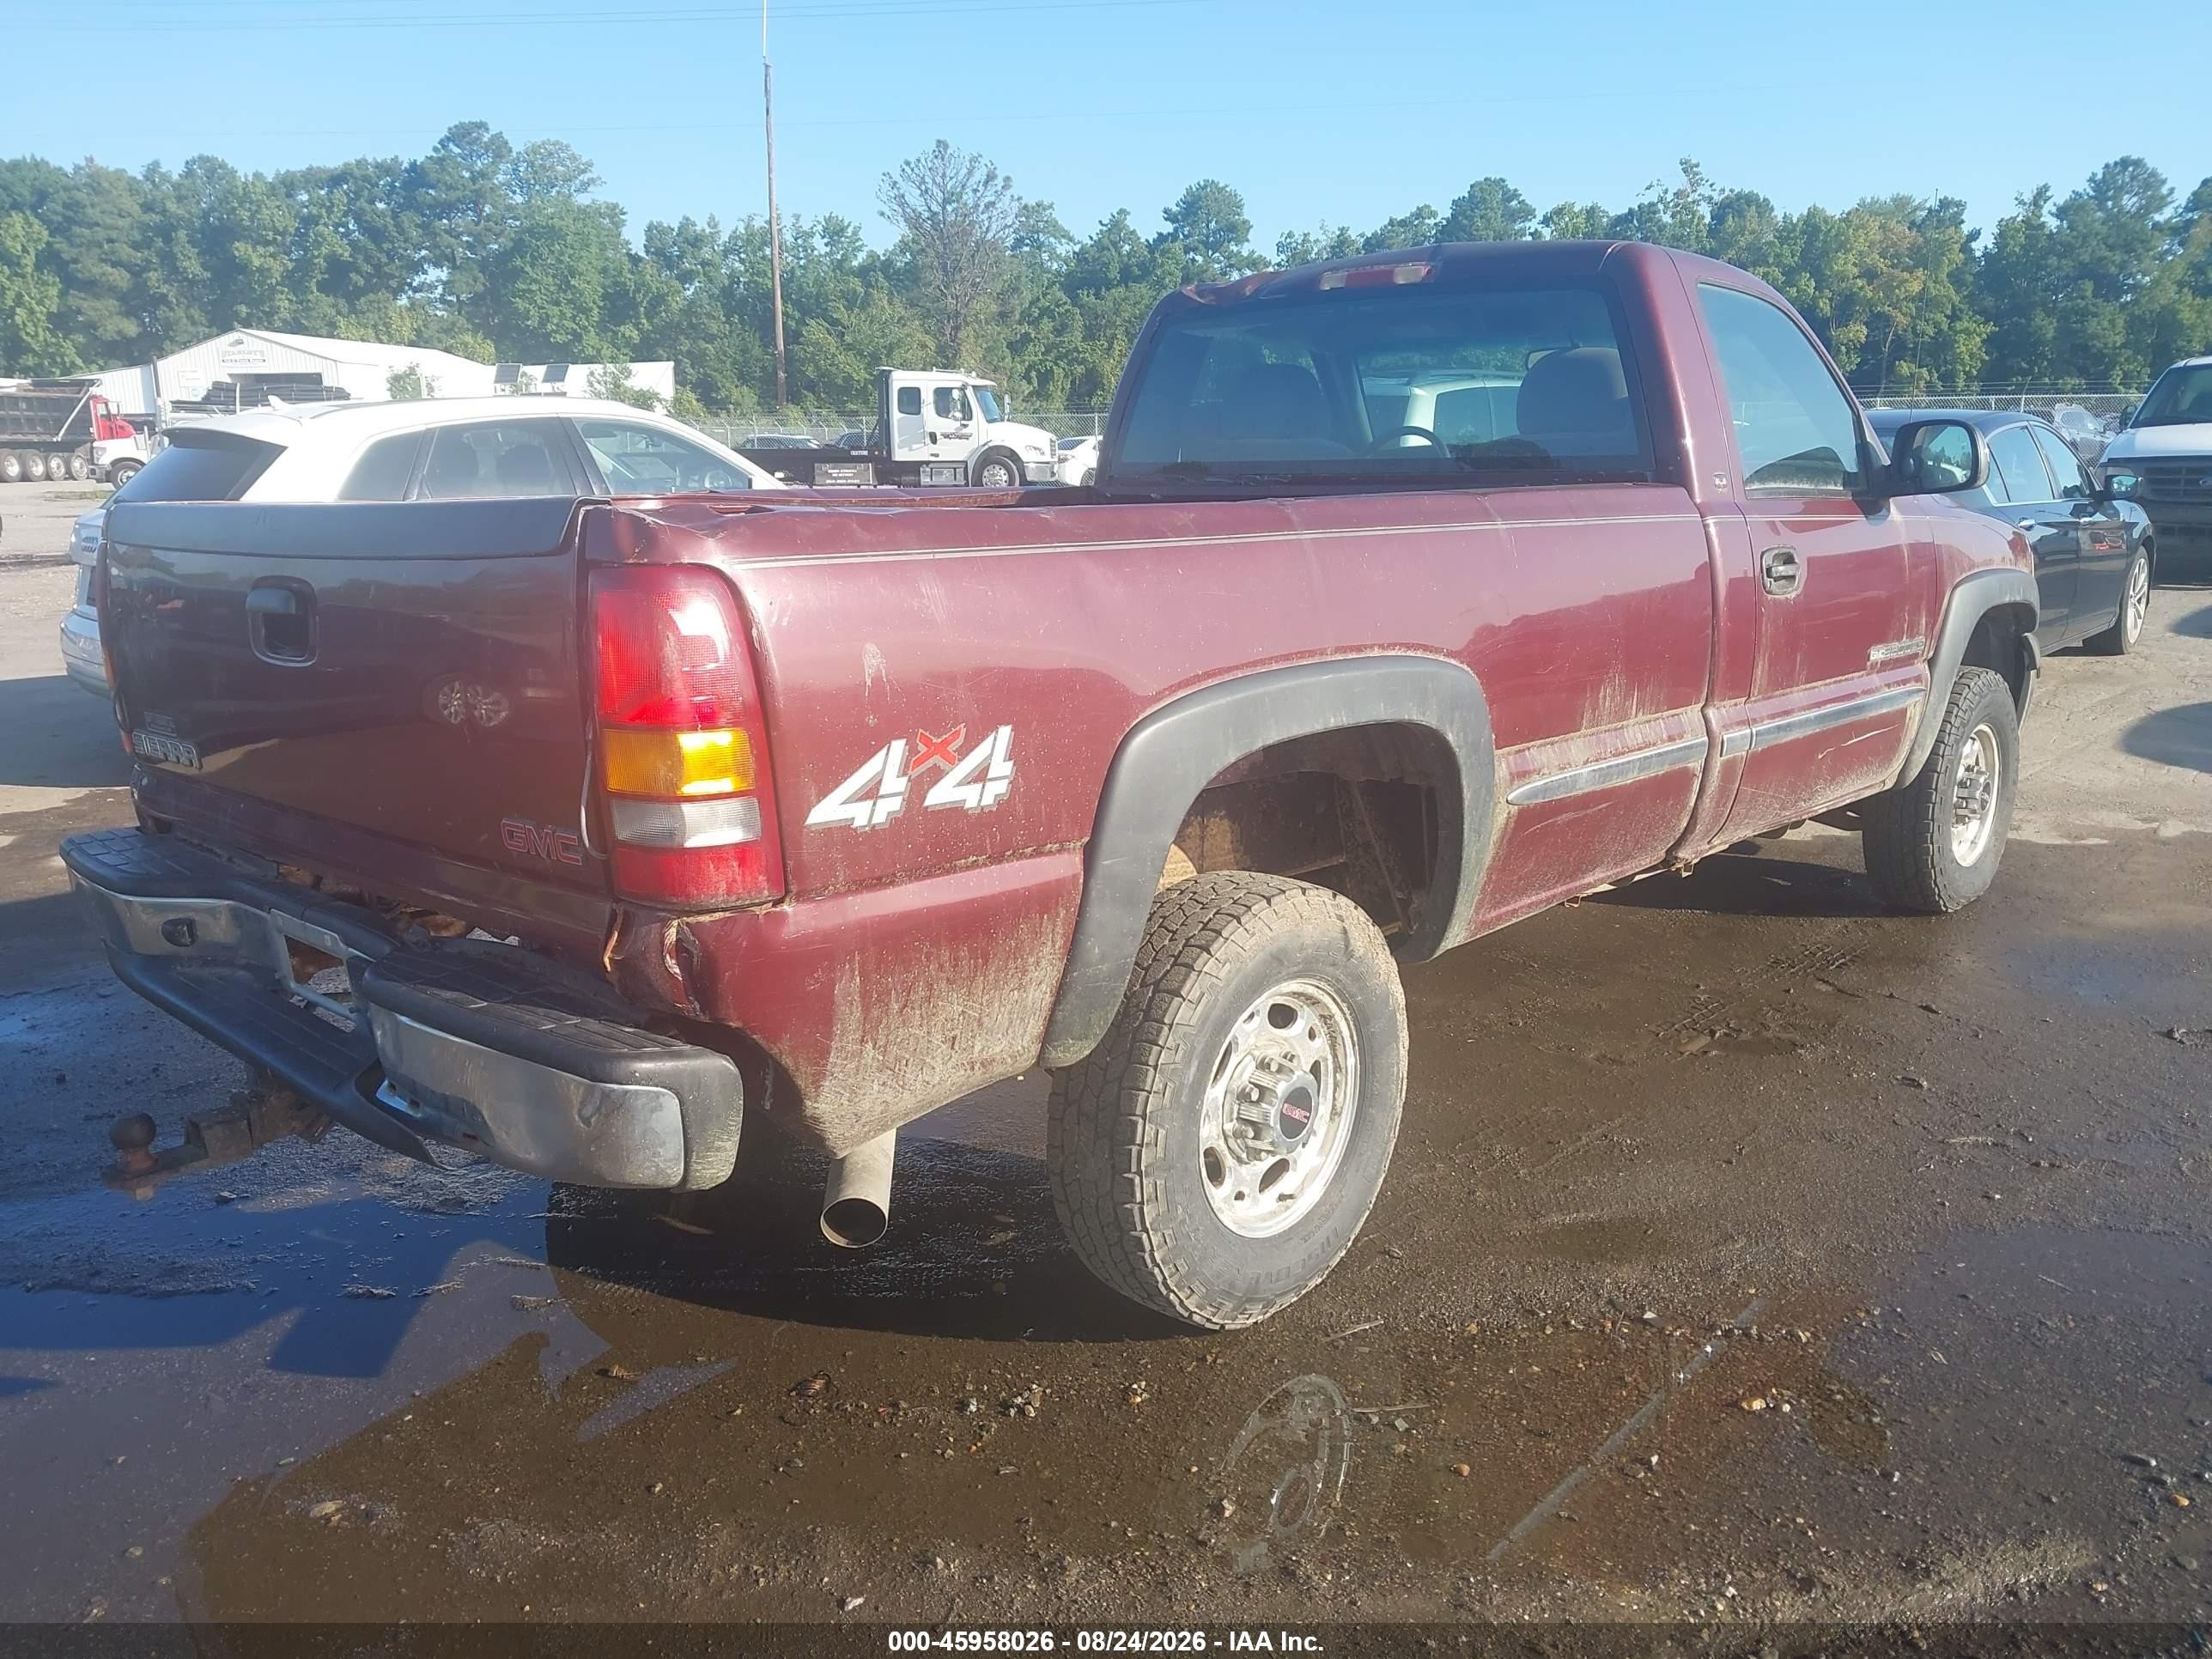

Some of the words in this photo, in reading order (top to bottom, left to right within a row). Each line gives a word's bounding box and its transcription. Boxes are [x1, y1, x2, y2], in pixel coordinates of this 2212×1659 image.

[132, 732, 200, 769] SIERRA
[501, 818, 582, 866] GMC
[1282, 1103, 1310, 1123] GMC
